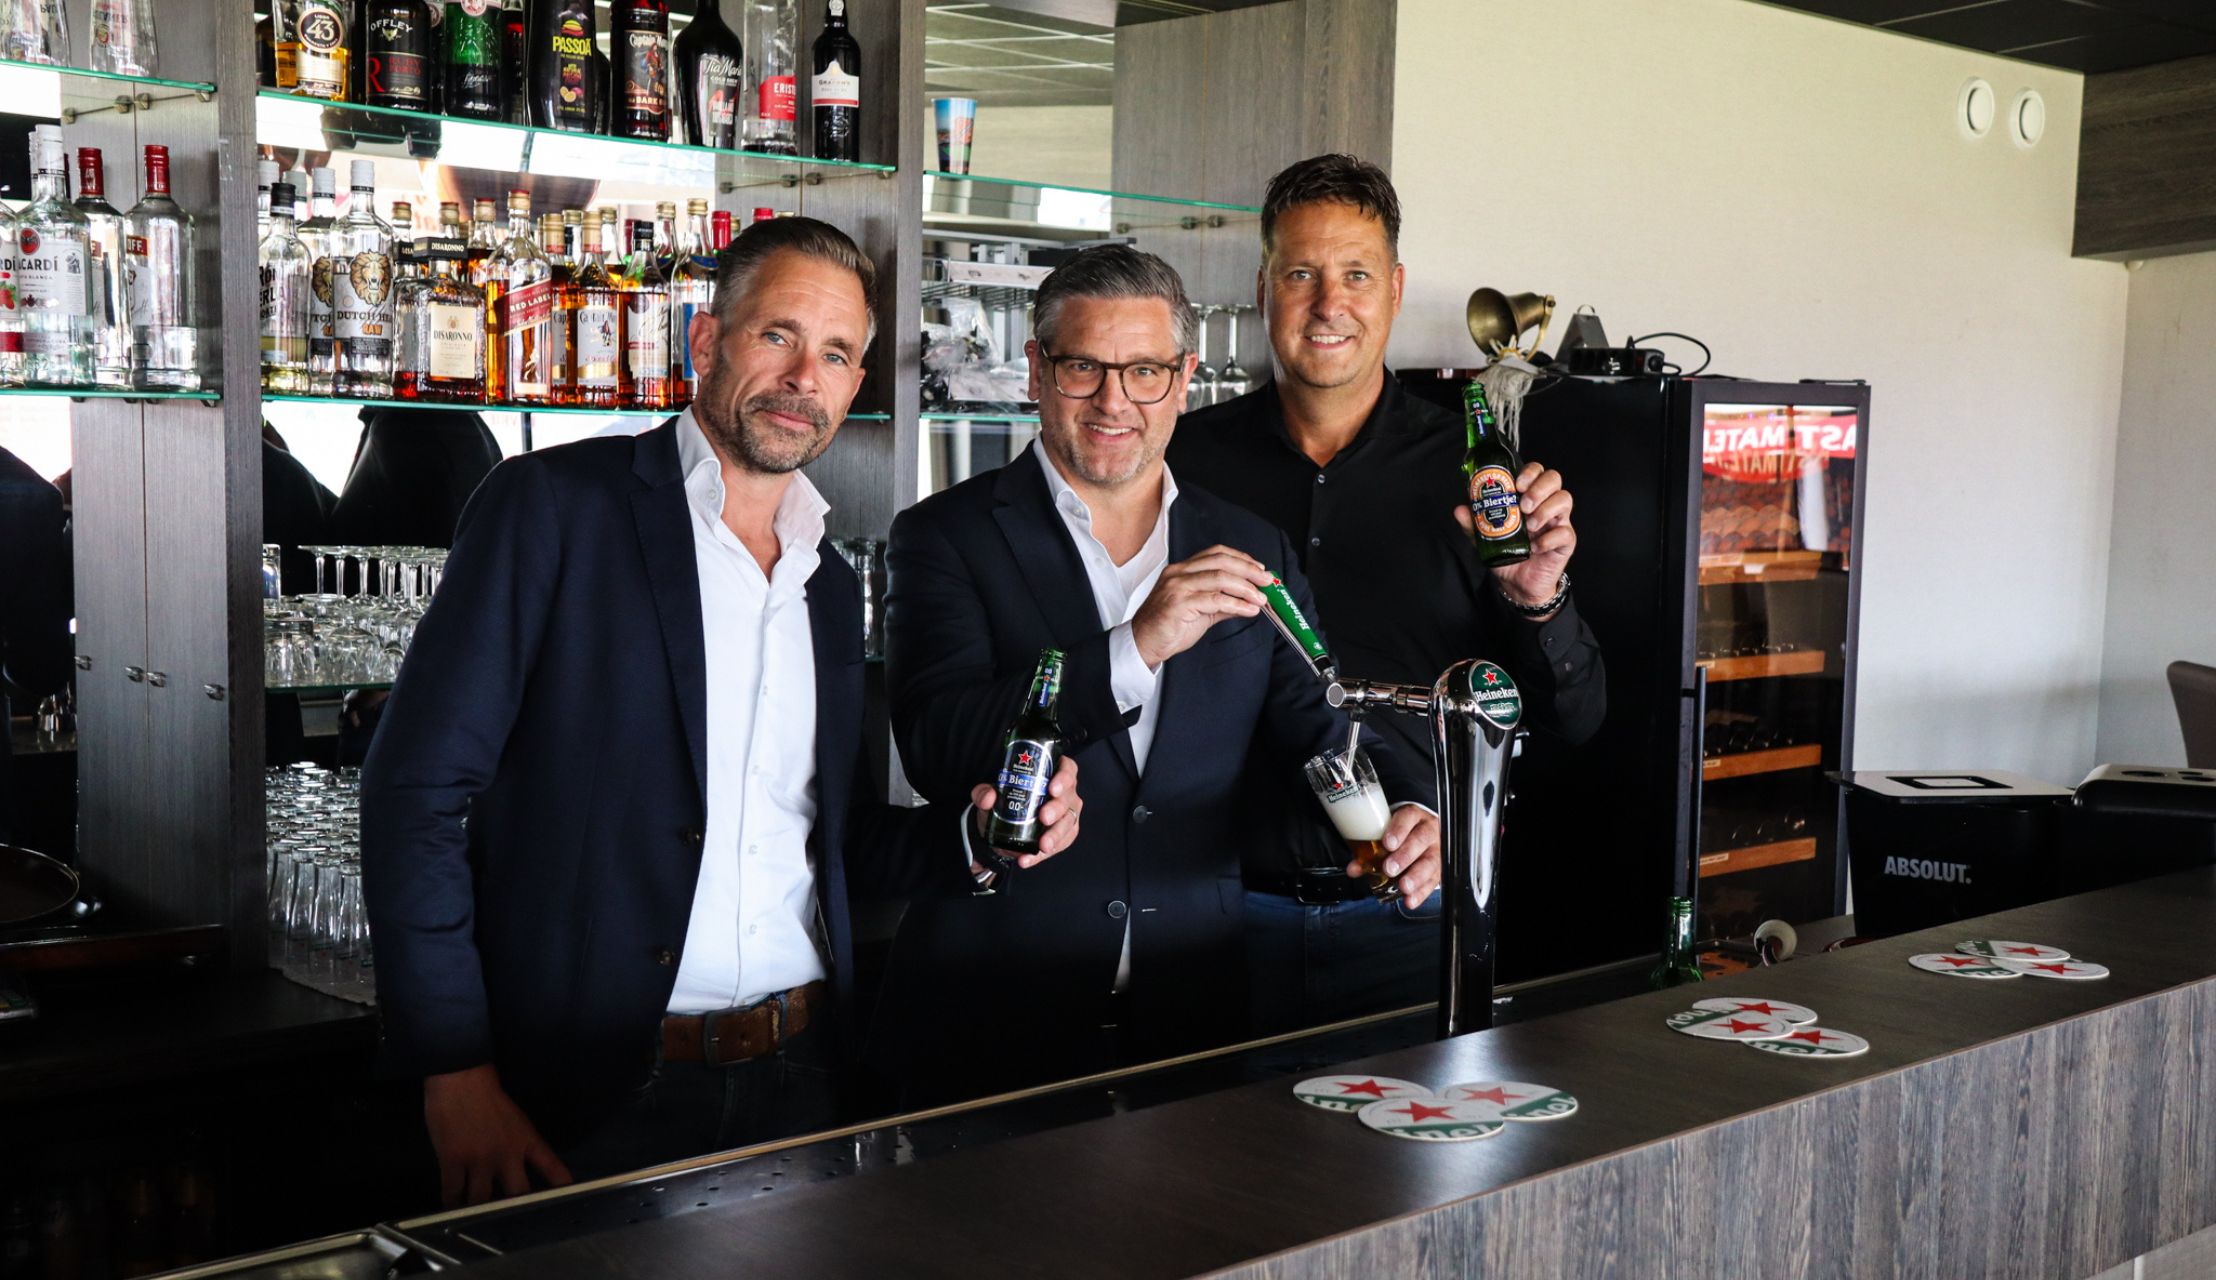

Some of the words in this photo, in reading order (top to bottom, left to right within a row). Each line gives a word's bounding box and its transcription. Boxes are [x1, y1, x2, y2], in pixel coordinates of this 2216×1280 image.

[306, 19, 335, 41] 43
[370, 18, 414, 33] OFFLEY
[629, 33, 656, 48] Captain
[704, 57, 721, 74] Tia
[718, 57, 742, 77] Mari
[431, 242, 465, 252] DISARONNO
[510, 302, 527, 313] RED
[337, 311, 375, 321] DUTCH
[433, 329, 473, 342] DISARONNO
[1483, 494, 1517, 508] Biertje?
[1277, 589, 1311, 631] Heineken
[1475, 686, 1519, 703] Heineken
